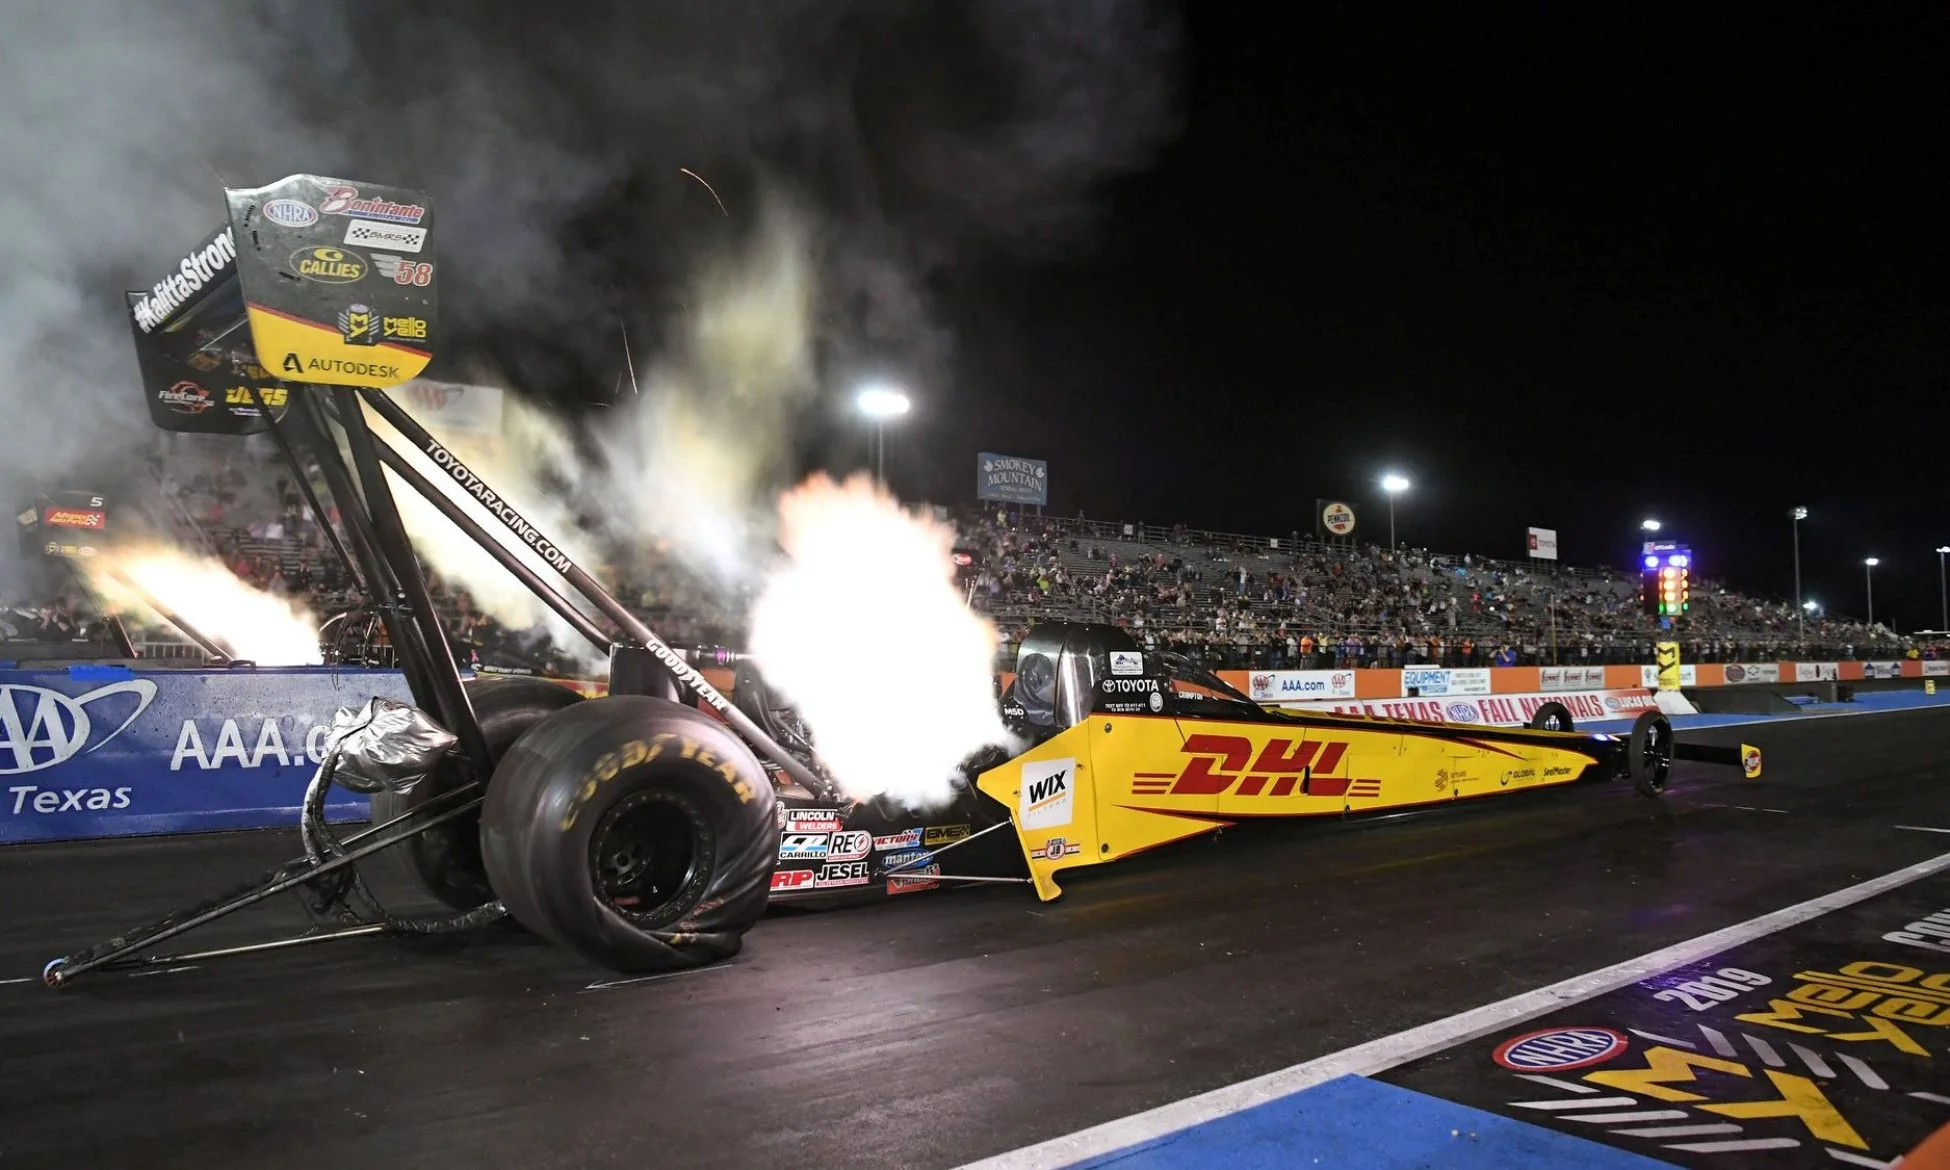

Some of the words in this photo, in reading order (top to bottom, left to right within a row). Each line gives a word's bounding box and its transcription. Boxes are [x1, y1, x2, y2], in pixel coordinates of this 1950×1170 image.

[269, 203, 313, 223] NHRA
[300, 259, 361, 279] CALLIES
[394, 260, 434, 287] 58
[308, 358, 400, 379] AUTODESK
[993, 459, 1036, 475] SMOKEY
[987, 471, 1042, 492] MOUNTAIN
[90, 496, 104, 507] 5
[425, 439, 572, 574] TOYOTARACING.COM
[645, 638, 730, 711] GOODYEAR
[1404, 671, 1451, 685] EQUIPMENT
[1115, 679, 1160, 692] TOYOTA
[1281, 679, 1325, 692] AAA.com
[1004, 707, 1024, 716] MSD
[1382, 701, 1445, 722] TEXAS
[1478, 699, 1519, 723] FALL
[1520, 695, 1606, 721] NANALS
[1169, 733, 1354, 797] DHL
[1028, 769, 1067, 804] WIX
[9, 786, 132, 814] Texas
[790, 811, 835, 821] LINCOLN
[800, 821, 838, 830] WELDERS
[780, 851, 827, 859] CARRILLO
[816, 863, 869, 881] JESEL
[1653, 967, 1773, 1011] 2019
[1509, 1030, 1612, 1066] NHRA
